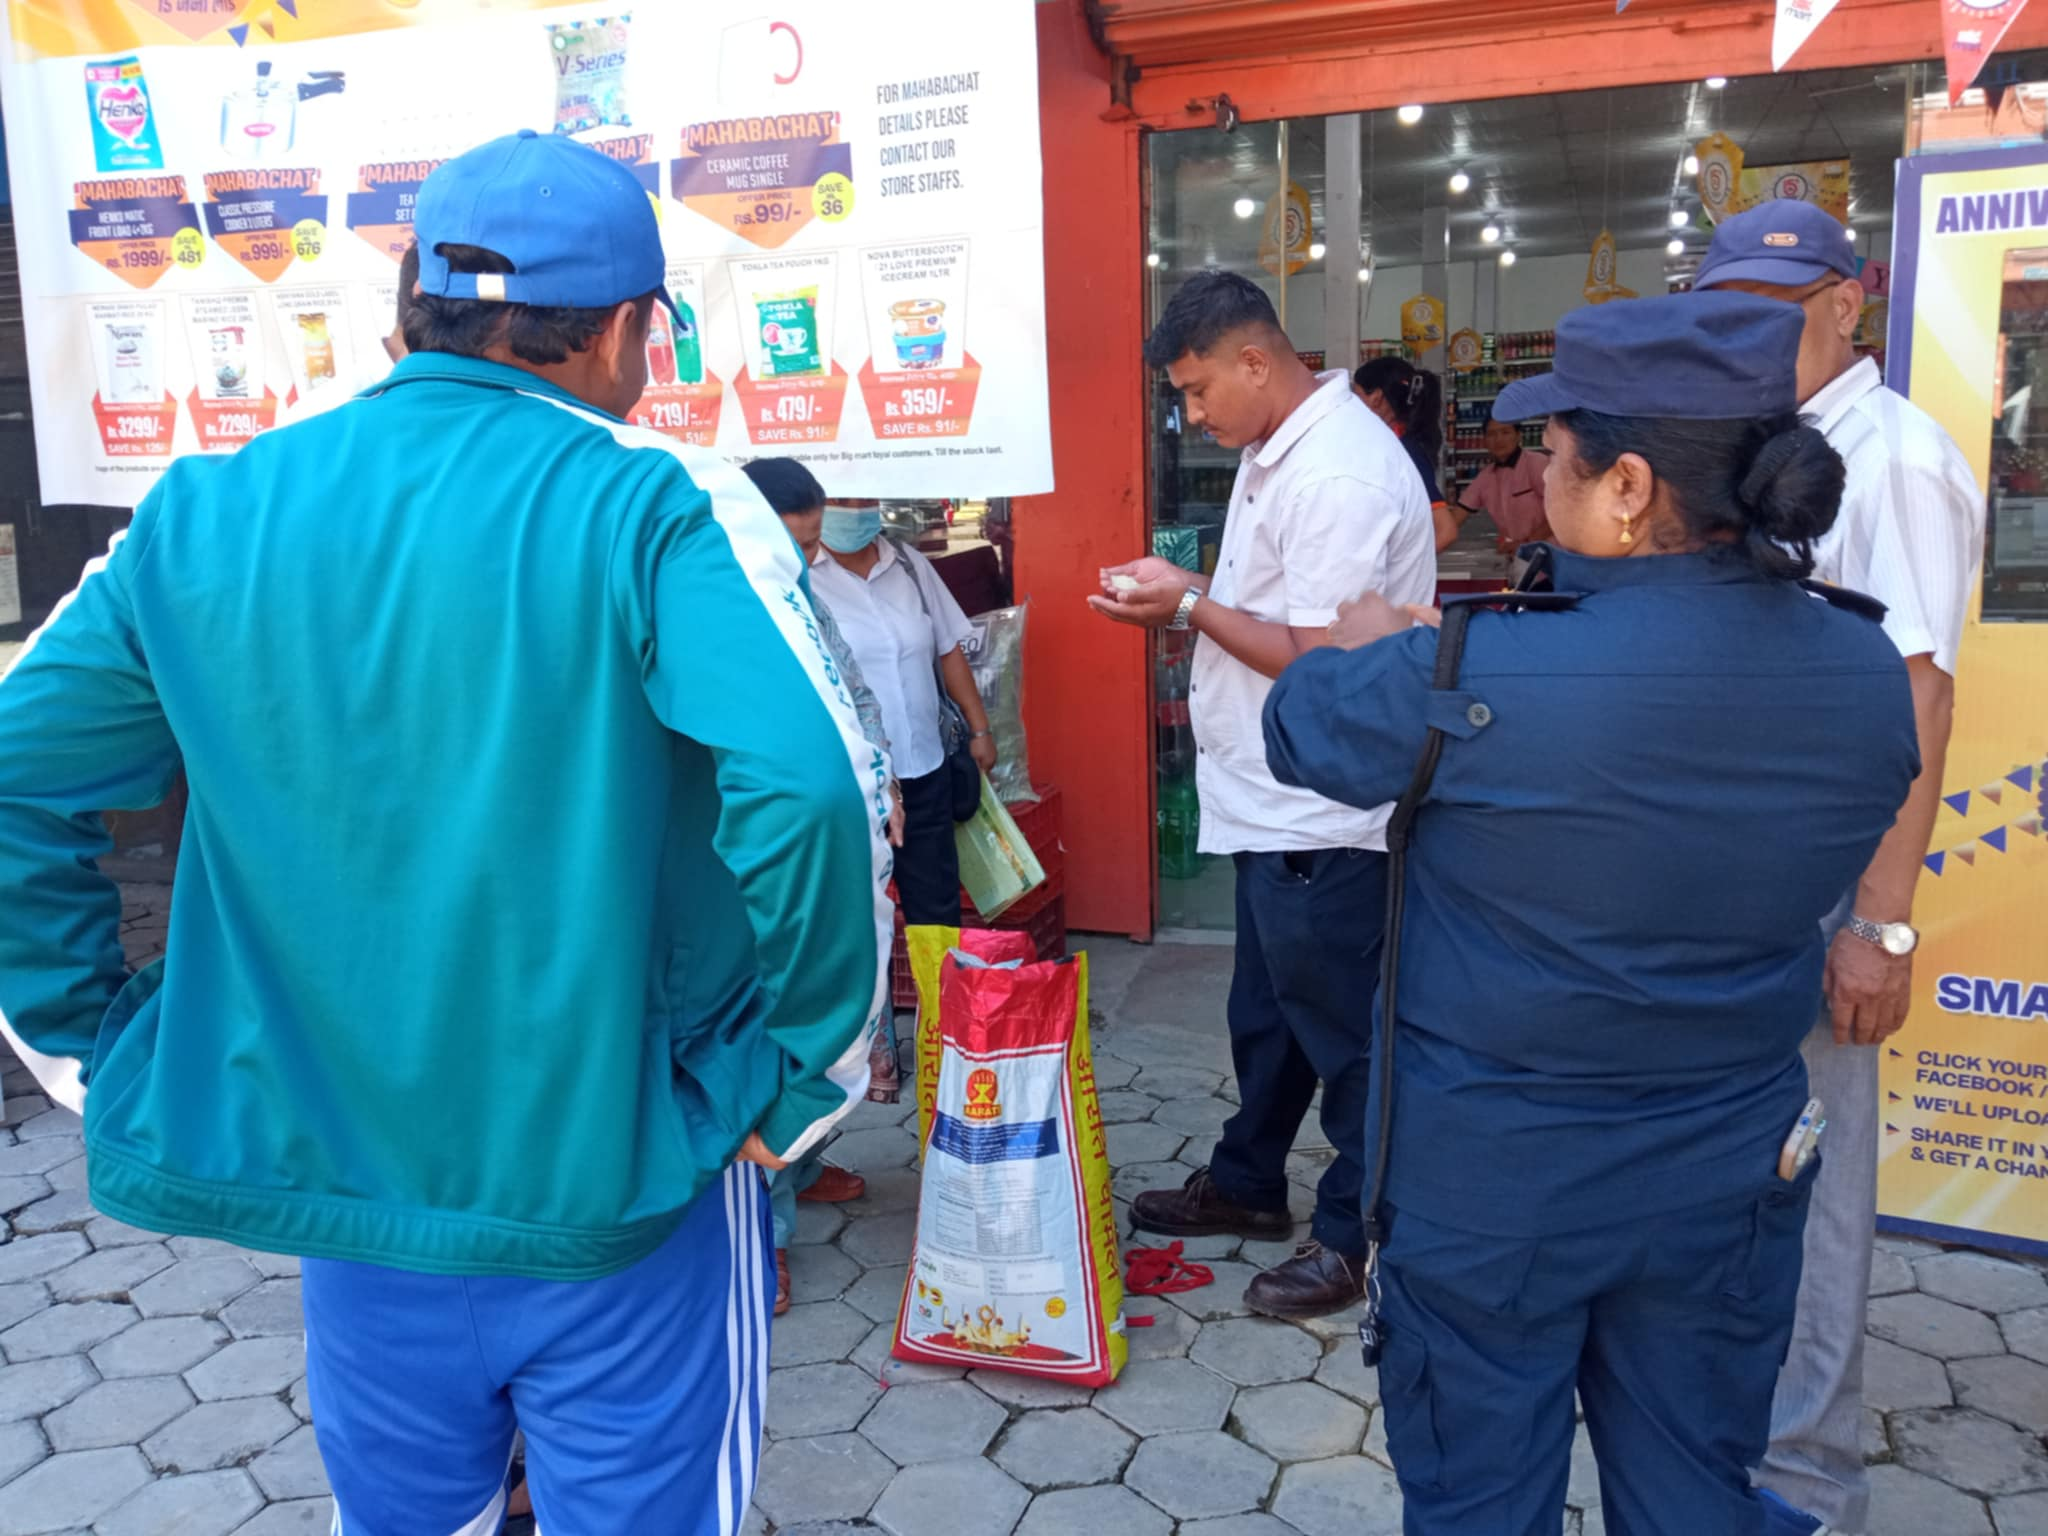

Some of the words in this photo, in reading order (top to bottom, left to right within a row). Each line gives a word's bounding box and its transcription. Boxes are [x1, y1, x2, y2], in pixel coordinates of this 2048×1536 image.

[877, 83, 899, 104] FOR
[902, 71, 980, 101] MAHABACHAT
[687, 112, 833, 148] MAHABACHAT
[879, 111, 922, 136] DETAILS
[926, 105, 969, 129] PLEASE
[707, 157, 750, 174] CERAMIC
[753, 153, 789, 170] COFFEE
[880, 142, 928, 167] CONTACT
[932, 139, 956, 160] OUR
[726, 174, 748, 189] MUG
[751, 170, 784, 187] SINGLE
[818, 183, 843, 194] SAVE
[881, 175, 915, 197] STORE
[918, 169, 965, 194] STAFFS.
[821, 200, 844, 216] 36
[1935, 189, 2048, 234] ANNIV
[758, 428, 787, 441] SAVE
[883, 423, 916, 436] SAVE
[1917, 1050, 1982, 1071] CLICK
[1987, 1058, 2047, 1080] YOUR
[1916, 1069, 2034, 1097] FACEBOOK
[1914, 1095, 1978, 1117] WE'LL
[1911, 1127, 1983, 1150] SHARE
[1988, 1137, 2007, 1153] IT
[2012, 1141, 2034, 1158] IN
[1911, 1146, 1925, 1161] &
[1930, 1150, 1970, 1168] GET
[1975, 1156, 1990, 1171] A
